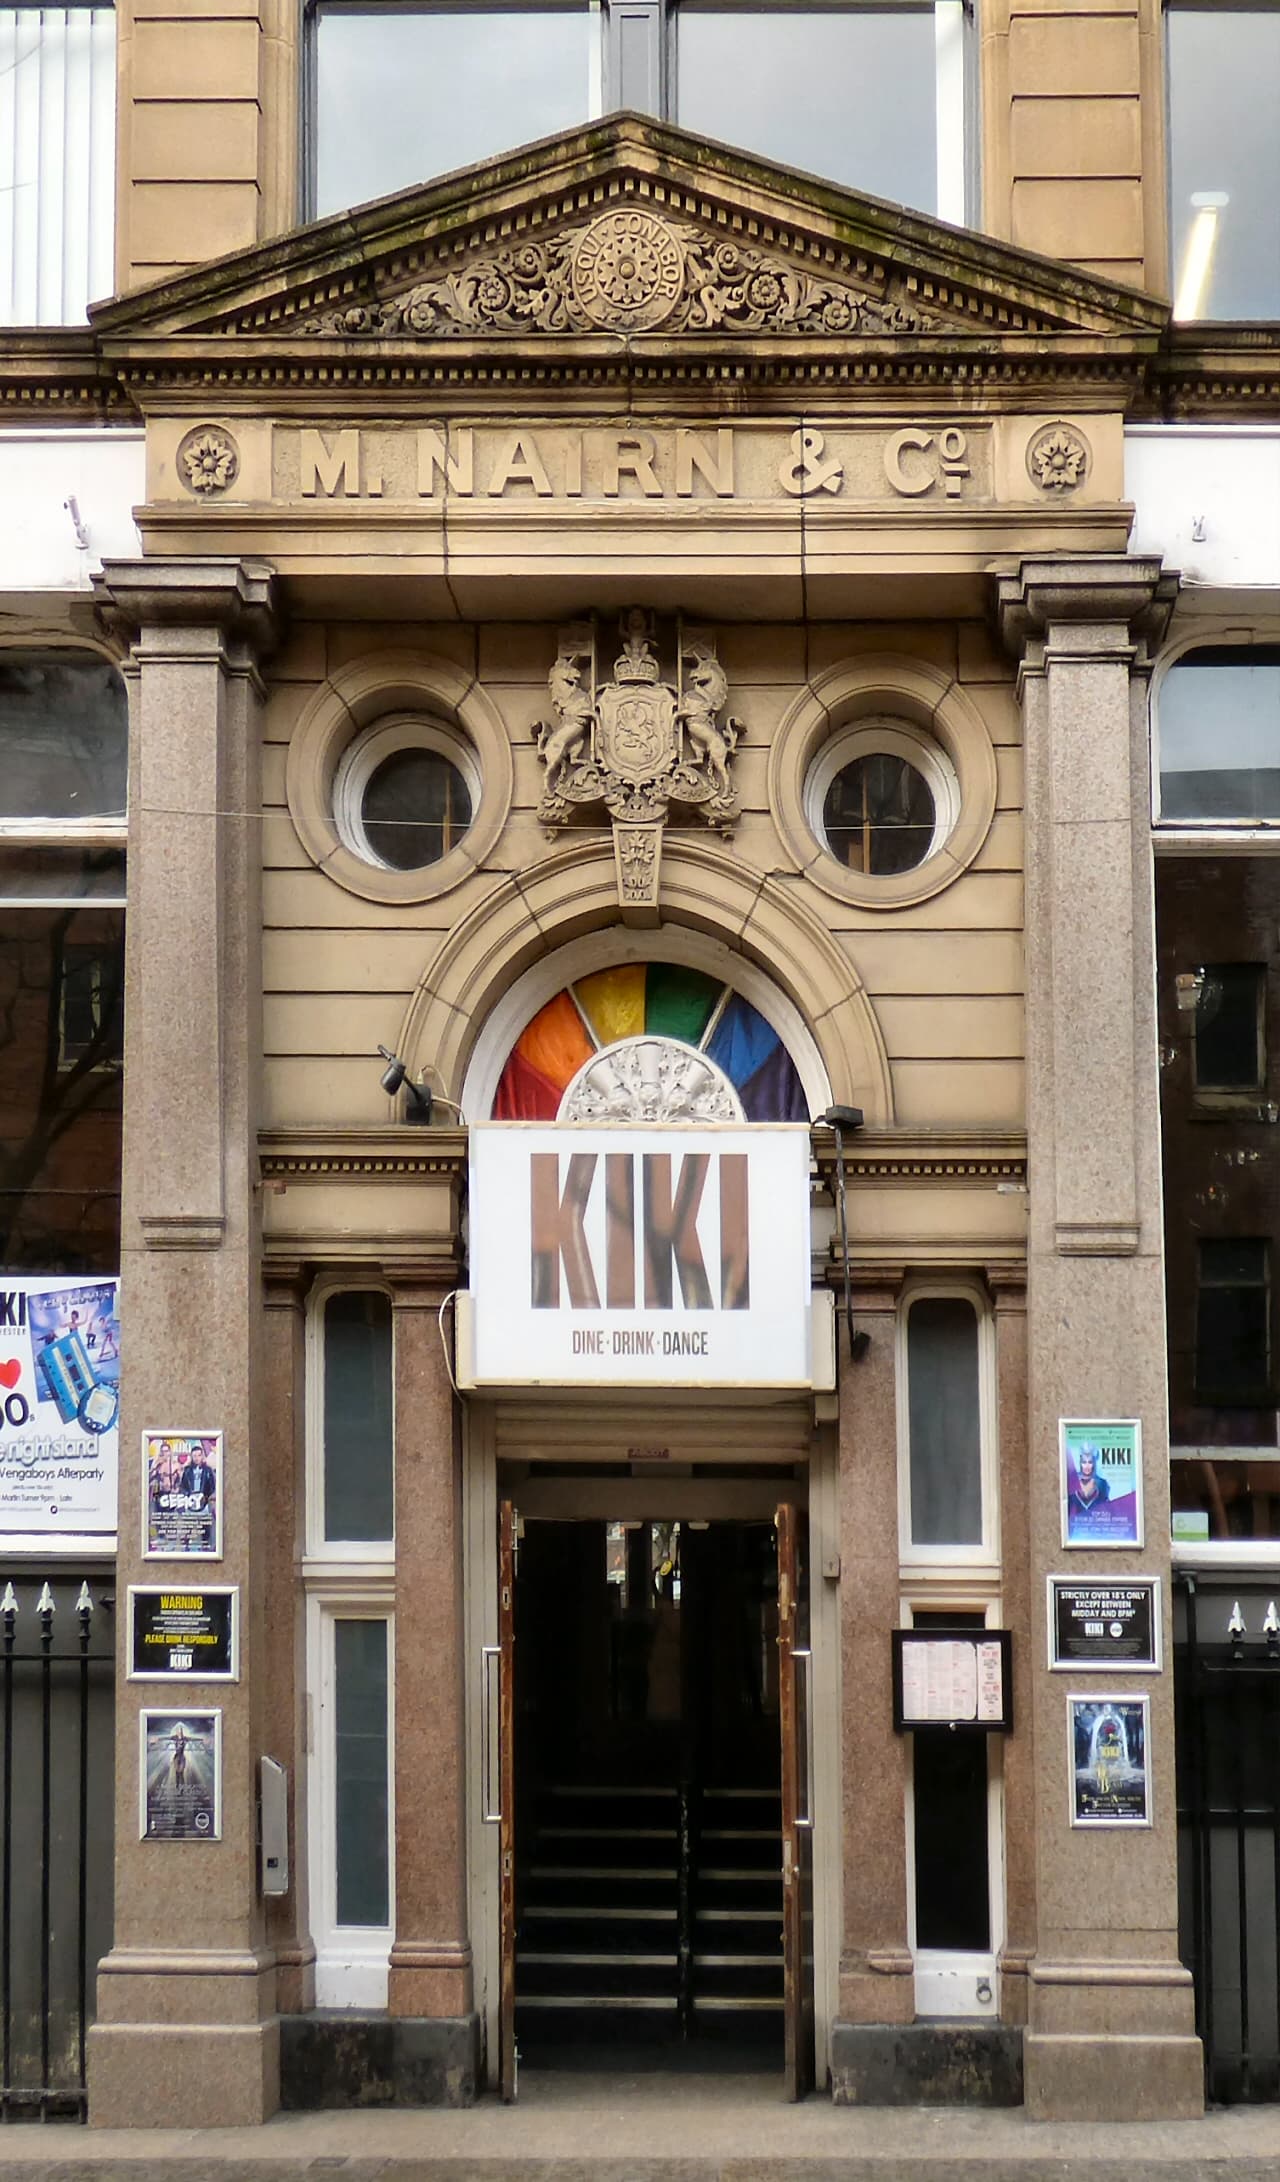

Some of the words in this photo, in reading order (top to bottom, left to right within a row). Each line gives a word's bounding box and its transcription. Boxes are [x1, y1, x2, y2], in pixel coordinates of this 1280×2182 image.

[300, 429, 383, 497] M.
[416, 428, 734, 498] NAIRN
[778, 427, 844, 495] &
[530, 1153, 750, 1310] KIKI
[572, 1330, 605, 1355] DINE
[612, 1330, 655, 1355] DRINK
[662, 1331, 709, 1356] DANCE
[1101, 1447, 1131, 1465] KIKI
[57, 1467, 104, 1481] Afterparty
[160, 1595, 203, 1609] WARNING
[1061, 1591, 1090, 1600] STRICTLY
[1090, 1591, 1110, 1600] OVER
[1126, 1591, 1146, 1600] ONLY
[1075, 1600, 1100, 1608] EXCEPT
[1101, 1600, 1131, 1608] BETWEEN
